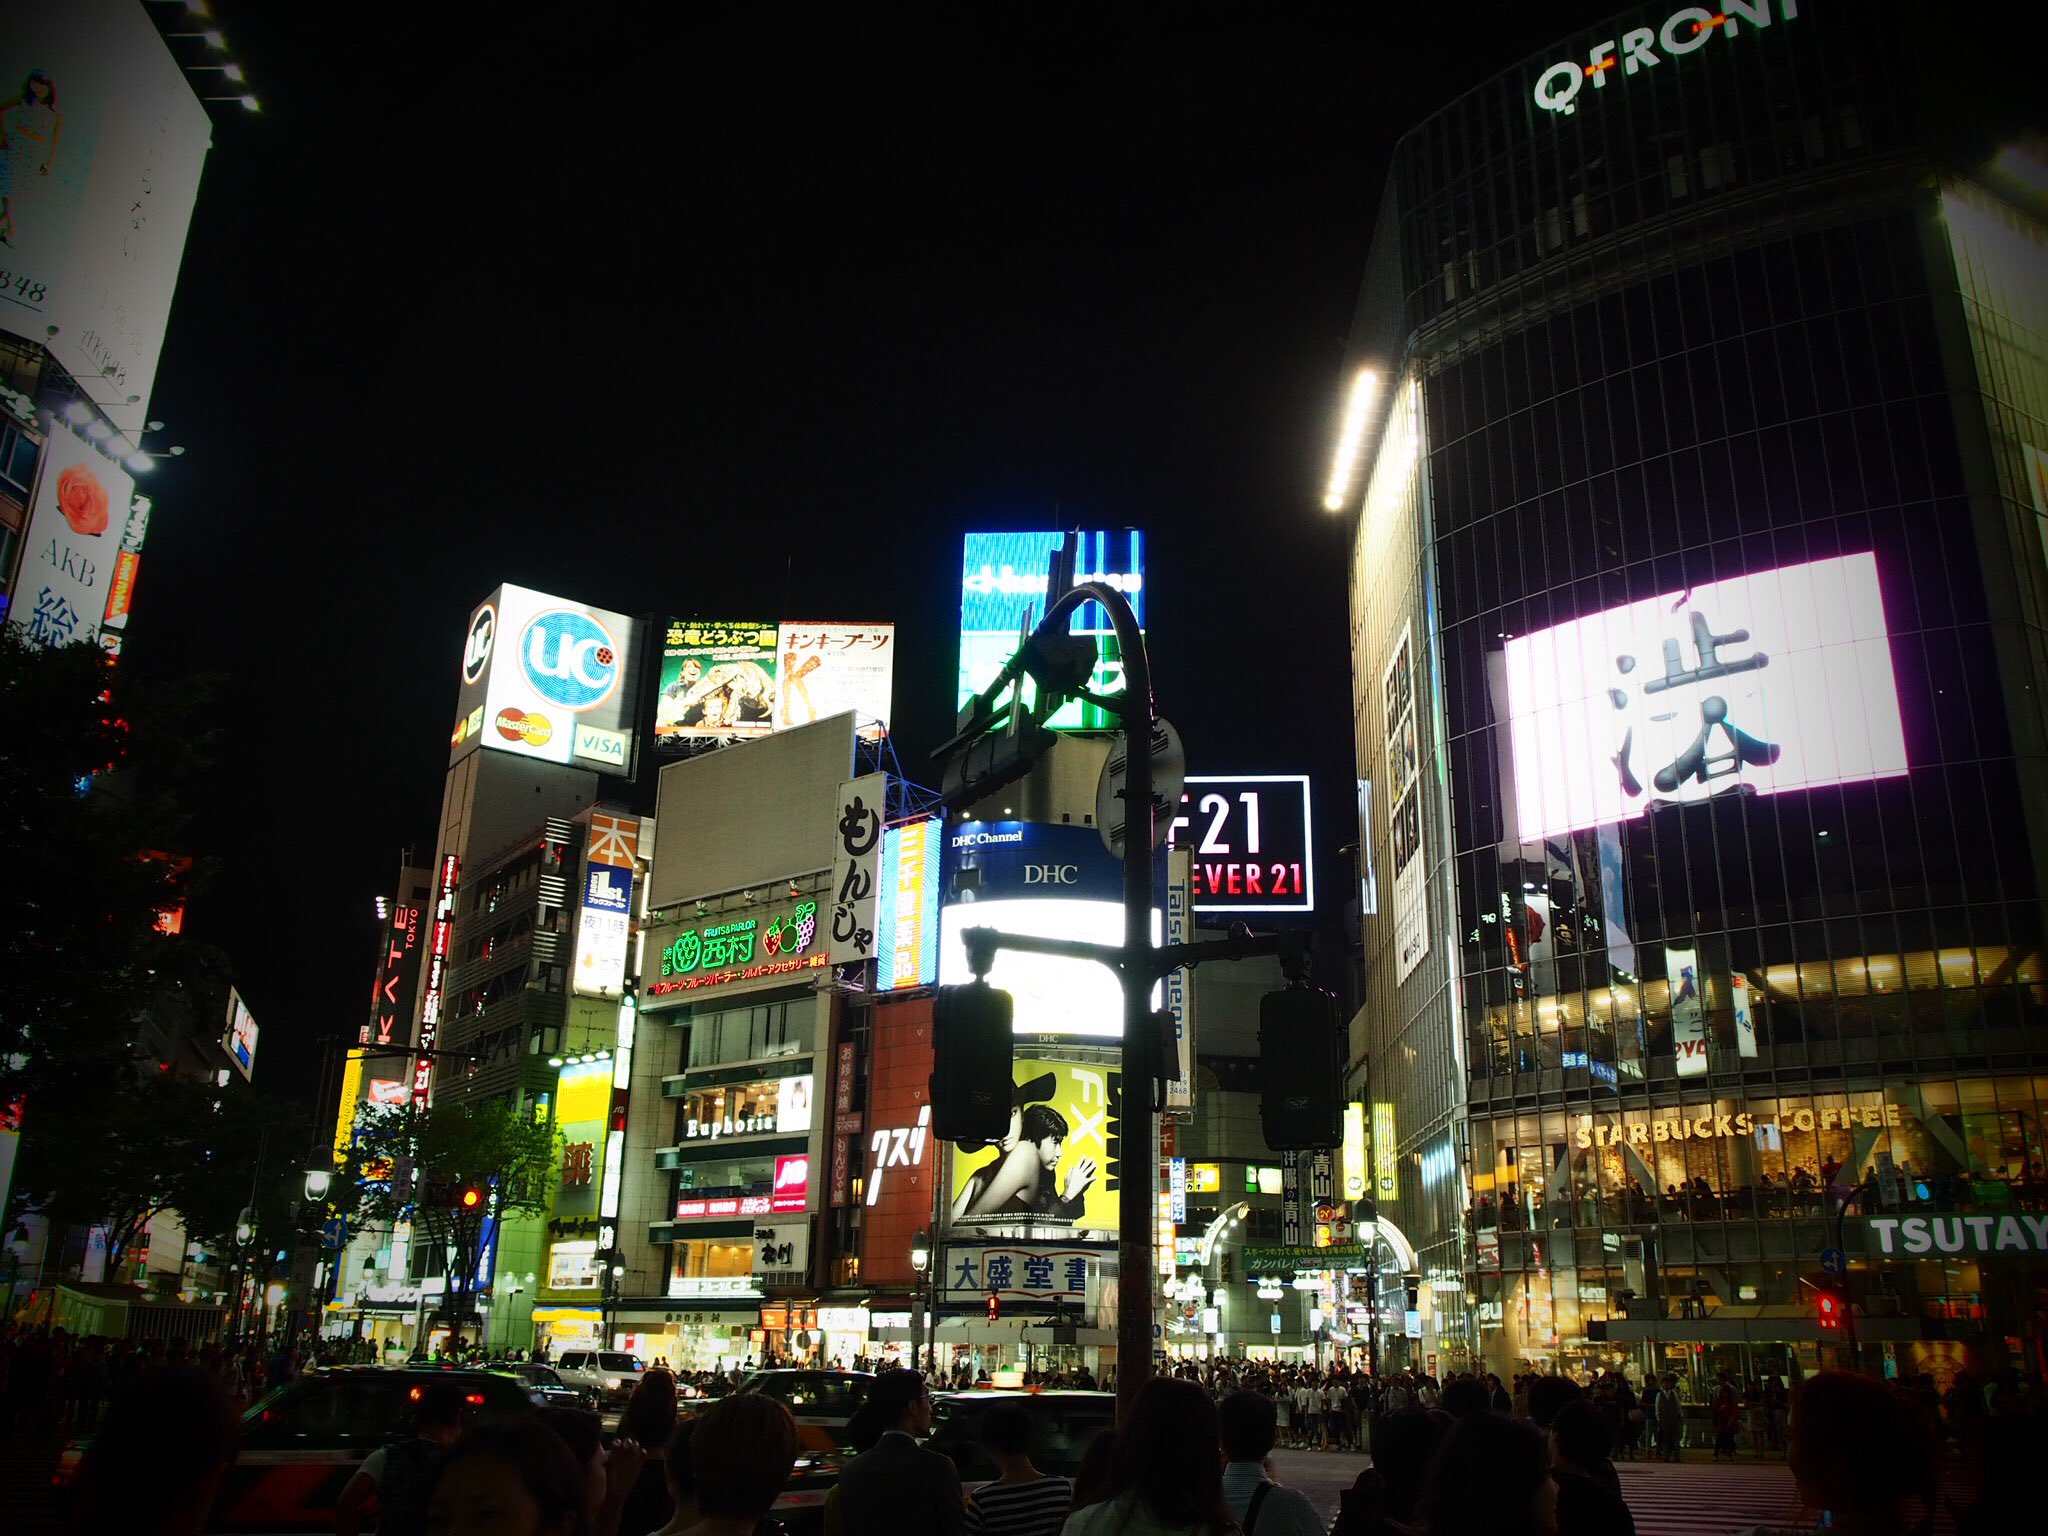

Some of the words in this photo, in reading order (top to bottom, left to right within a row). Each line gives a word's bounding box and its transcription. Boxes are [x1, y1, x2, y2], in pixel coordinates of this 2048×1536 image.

[40, 538, 96, 587] AKB
[666, 629, 777, 646] 恐竜どうぶつ園
[785, 633, 889, 650] キンキーブーツ
[496, 715, 552, 736] MasterCard
[583, 735, 622, 756] VISA
[951, 834, 975, 848] DHC
[976, 831, 1023, 846] Channel
[832, 795, 881, 955] もんじゃ
[1024, 865, 1078, 884] DHC
[1271, 864, 1302, 894] 21
[405, 908, 419, 949] TOKYO
[661, 947, 673, 976] 渋谷
[702, 932, 754, 969] 西村
[378, 907, 408, 1043] KATE
[1038, 1034, 1059, 1044] DHC
[1169, 1087, 1188, 1095] 2468
[1070, 1068, 1105, 1148] FX
[687, 1116, 774, 1140] Euphoria
[1576, 1113, 1754, 1150] STARBUCKS
[1774, 1103, 1901, 1133] COFFEE
[866, 1104, 932, 1206] クスリ
[1283, 1150, 1299, 1247] 洋服の青山
[954, 1256, 1087, 1291] 大盛堂書
